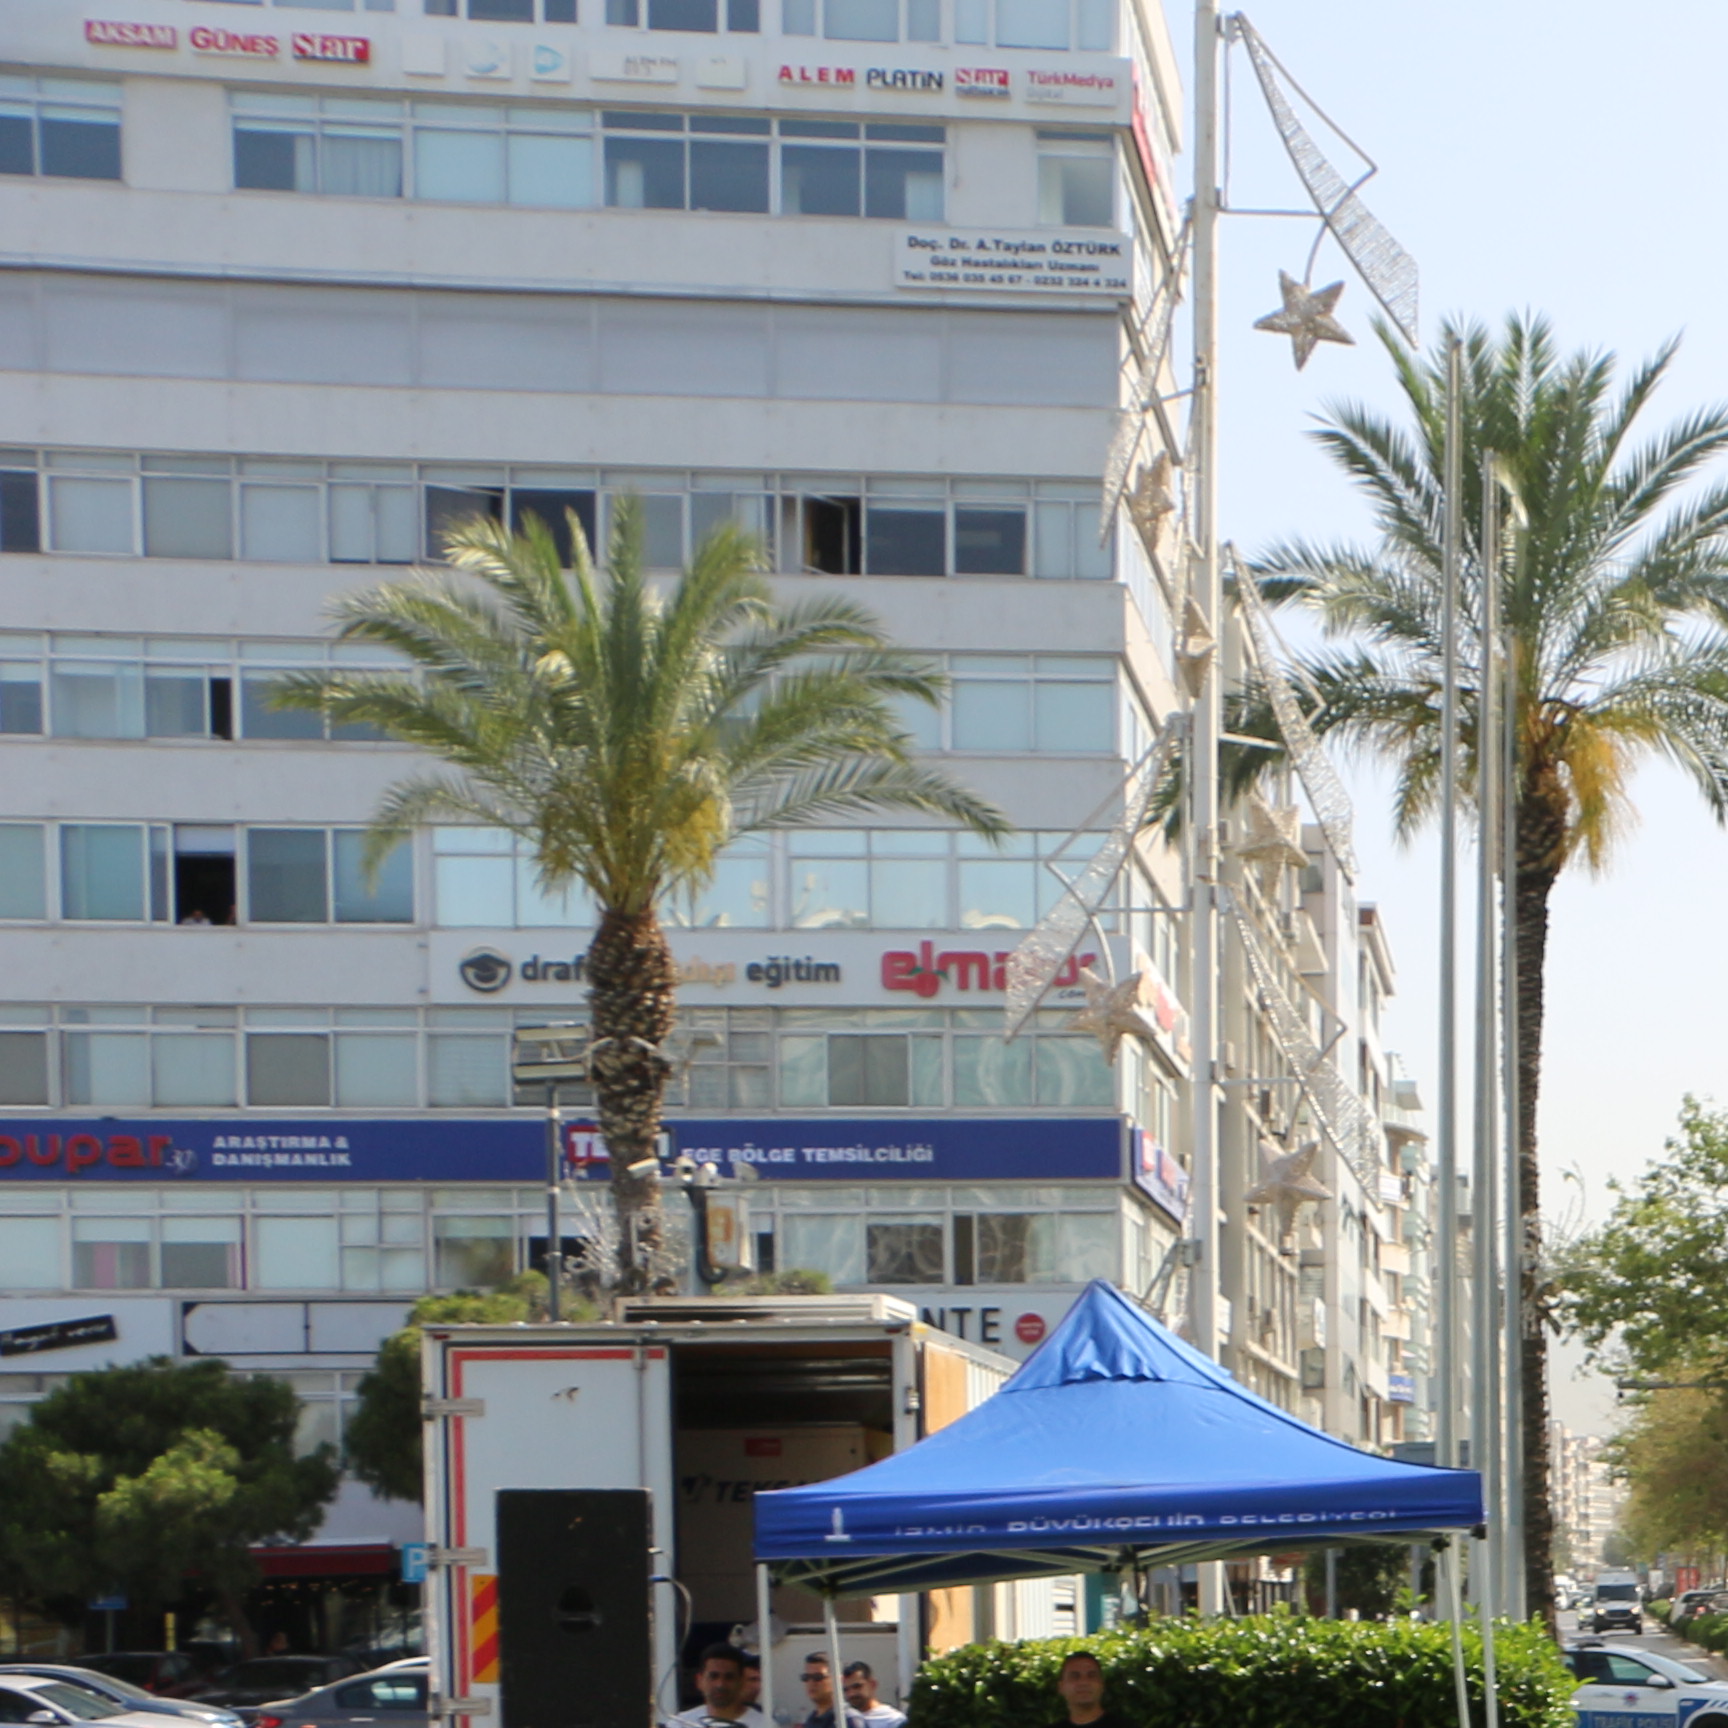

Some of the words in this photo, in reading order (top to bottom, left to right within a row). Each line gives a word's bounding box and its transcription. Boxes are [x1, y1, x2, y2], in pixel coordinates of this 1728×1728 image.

[293, 34, 361, 59] Star
[1026, 69, 1115, 90] TürkMedya
[907, 235, 943, 252] Doç.
[949, 237, 970, 251] Dr.
[1052, 239, 1121, 256] ÖZTÜRK
[930, 255, 958, 268] Göz
[745, 955, 842, 988] eğitim
[212, 1135, 332, 1150] ARAŞTIRMA
[728, 1142, 796, 1163] BÖLGE
[802, 1143, 934, 1163] TEMSİLCİLİĞİ
[211, 1152, 352, 1168] DANIŞMANLIK
